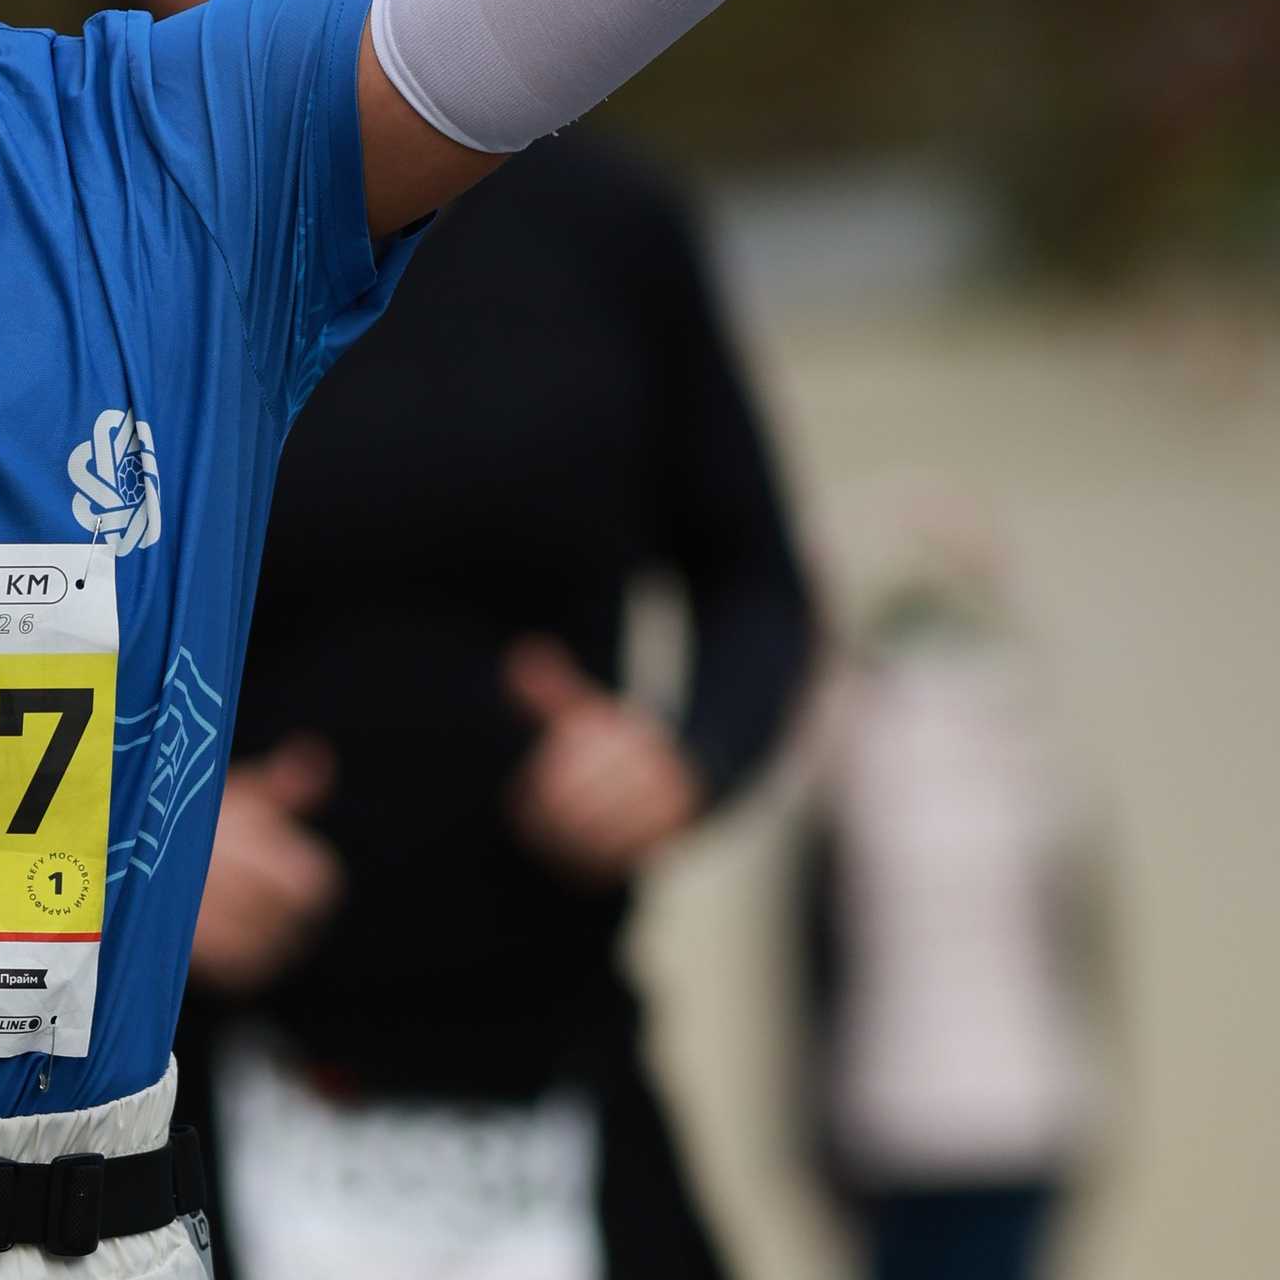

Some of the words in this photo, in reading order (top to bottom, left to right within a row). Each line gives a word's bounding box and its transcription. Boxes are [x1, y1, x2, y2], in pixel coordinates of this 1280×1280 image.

[6, 573, 50, 596] КМ
[27, 857, 44, 881] БЕГУ
[49, 852, 90, 909] МОСКОВСКИЙ
[48, 871, 63, 895] 1
[26, 885, 71, 916] МАРАФОН
[0, 973, 38, 985] Прайм
